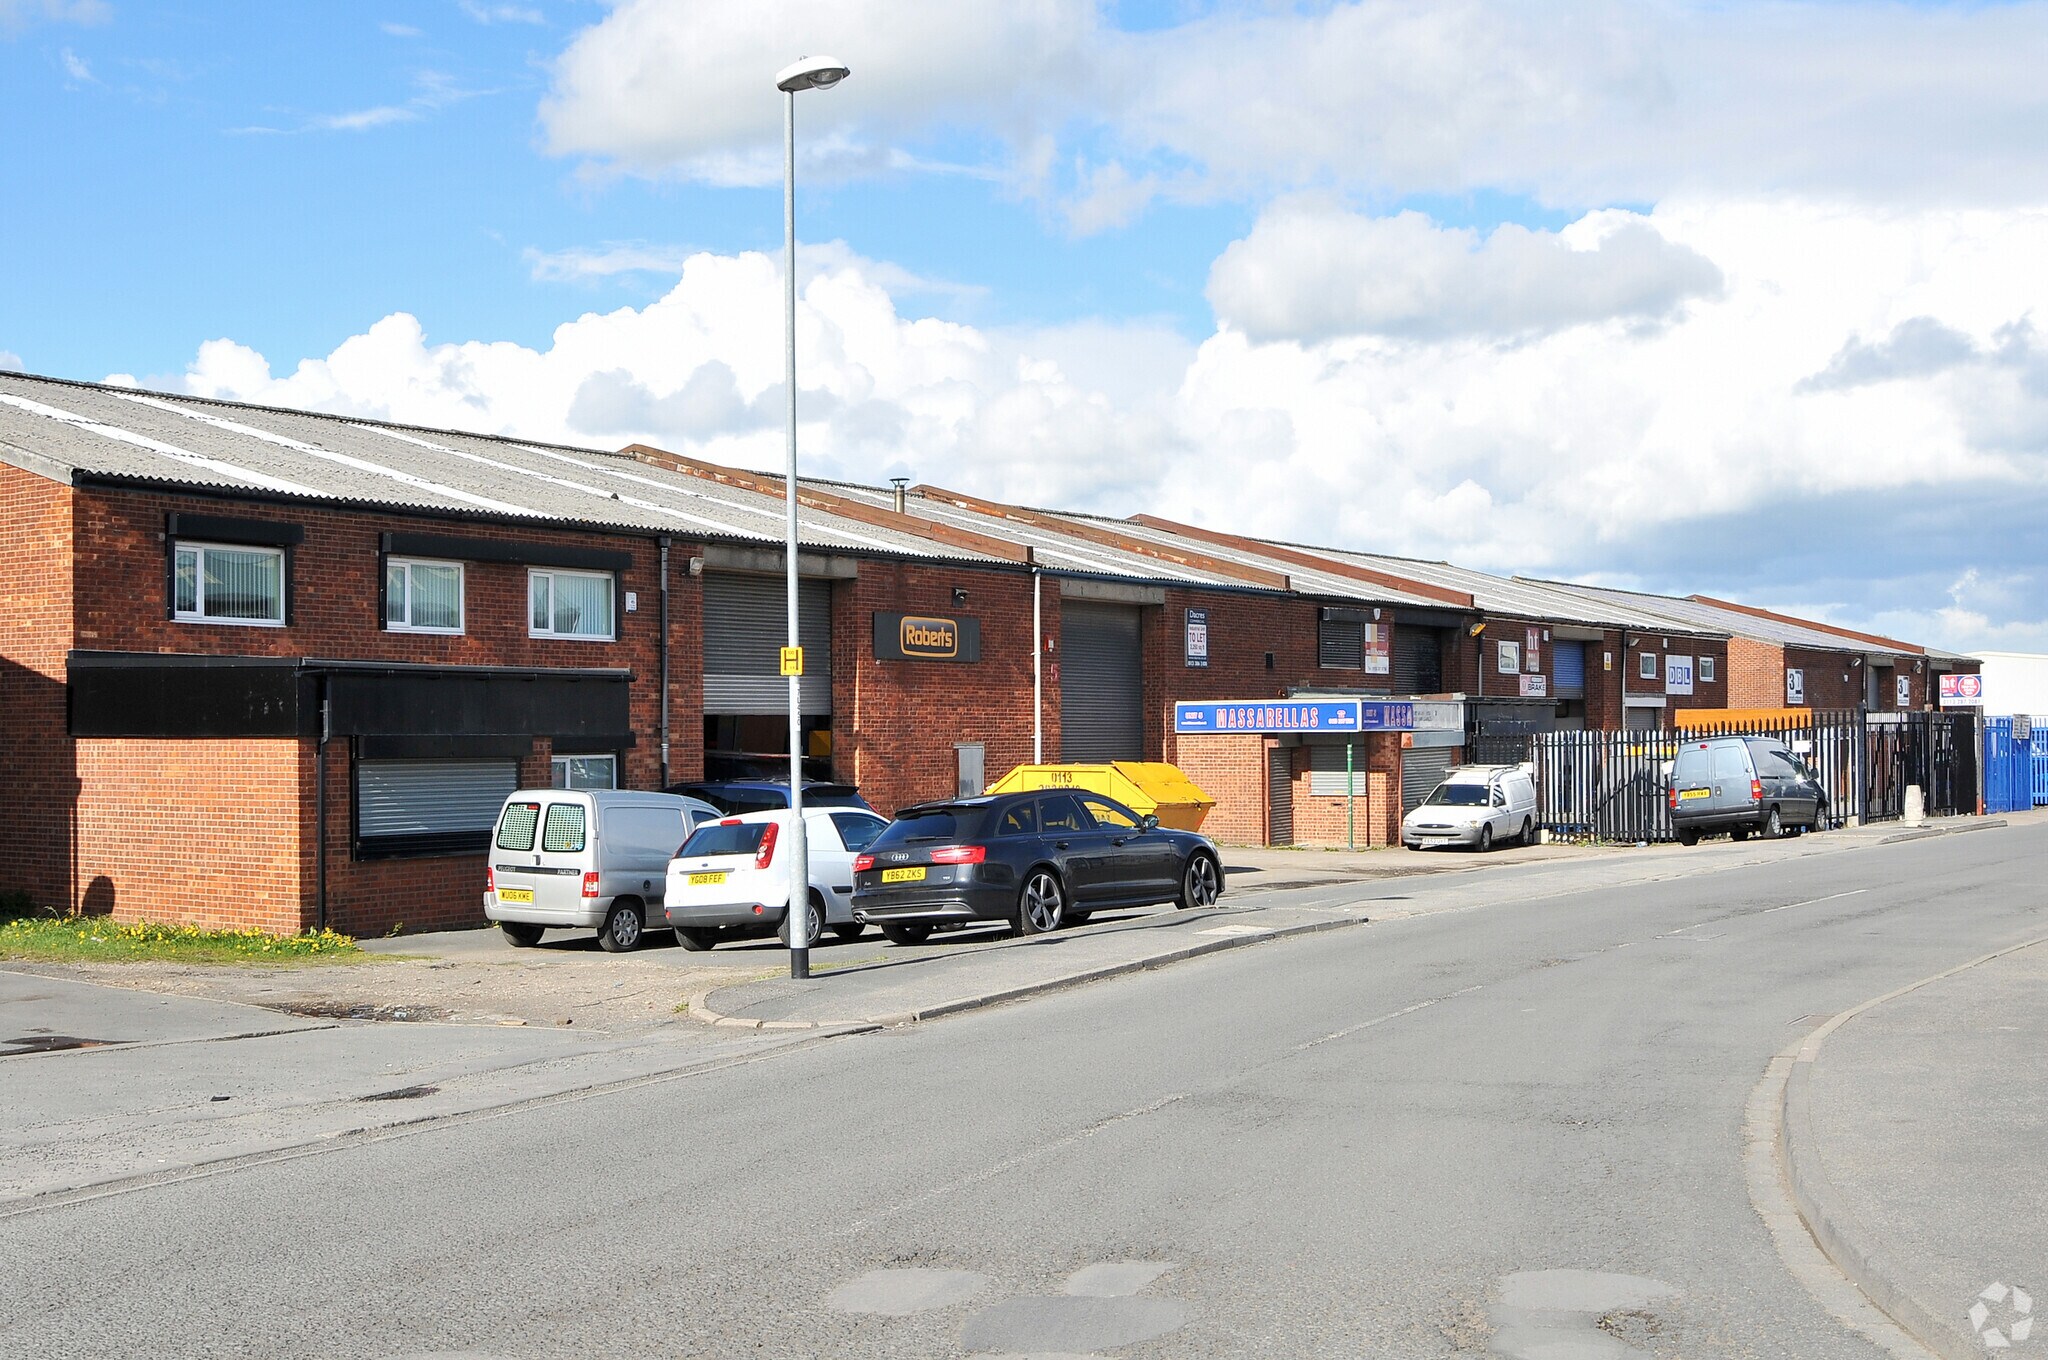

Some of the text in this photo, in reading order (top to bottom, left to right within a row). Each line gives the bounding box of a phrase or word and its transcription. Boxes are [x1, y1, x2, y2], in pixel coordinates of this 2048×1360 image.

[1189, 610, 1205, 619] Dacres
[906, 625, 952, 647] Roberts
[1189, 632, 1206, 642] TO LET
[1527, 630, 1539, 650] ht
[784, 650, 799, 671] H
[1669, 666, 1690, 685] DBL
[1941, 677, 1956, 688] ht
[1216, 708, 1319, 728] MASSARELLAS
[1383, 705, 1412, 727] MASSA
[1051, 772, 1073, 783] 0113
[690, 874, 722, 884] YG08 FEF
[886, 869, 922, 880] YB62 ZKS
